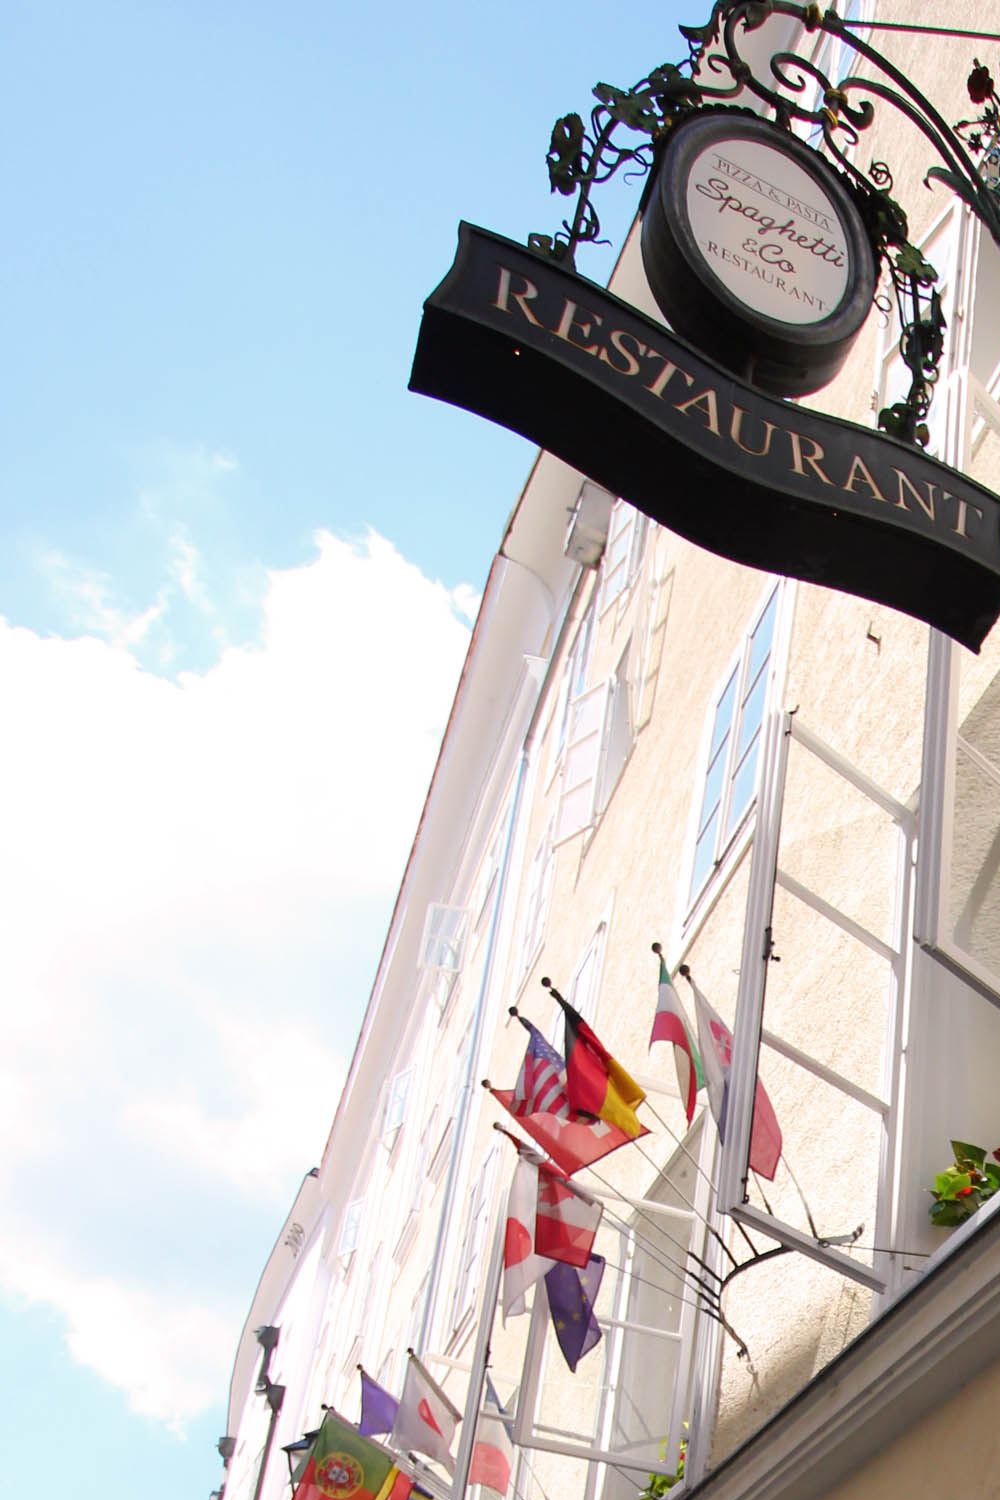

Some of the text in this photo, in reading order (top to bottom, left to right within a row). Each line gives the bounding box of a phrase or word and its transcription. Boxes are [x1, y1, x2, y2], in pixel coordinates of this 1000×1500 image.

[695, 178, 844, 268] Spaghetti
[717, 159, 764, 193] PIZZA
[787, 197, 831, 230] PASTA
[707, 241, 826, 312] RESTAURANT
[495, 268, 985, 539] RESTAURANT
